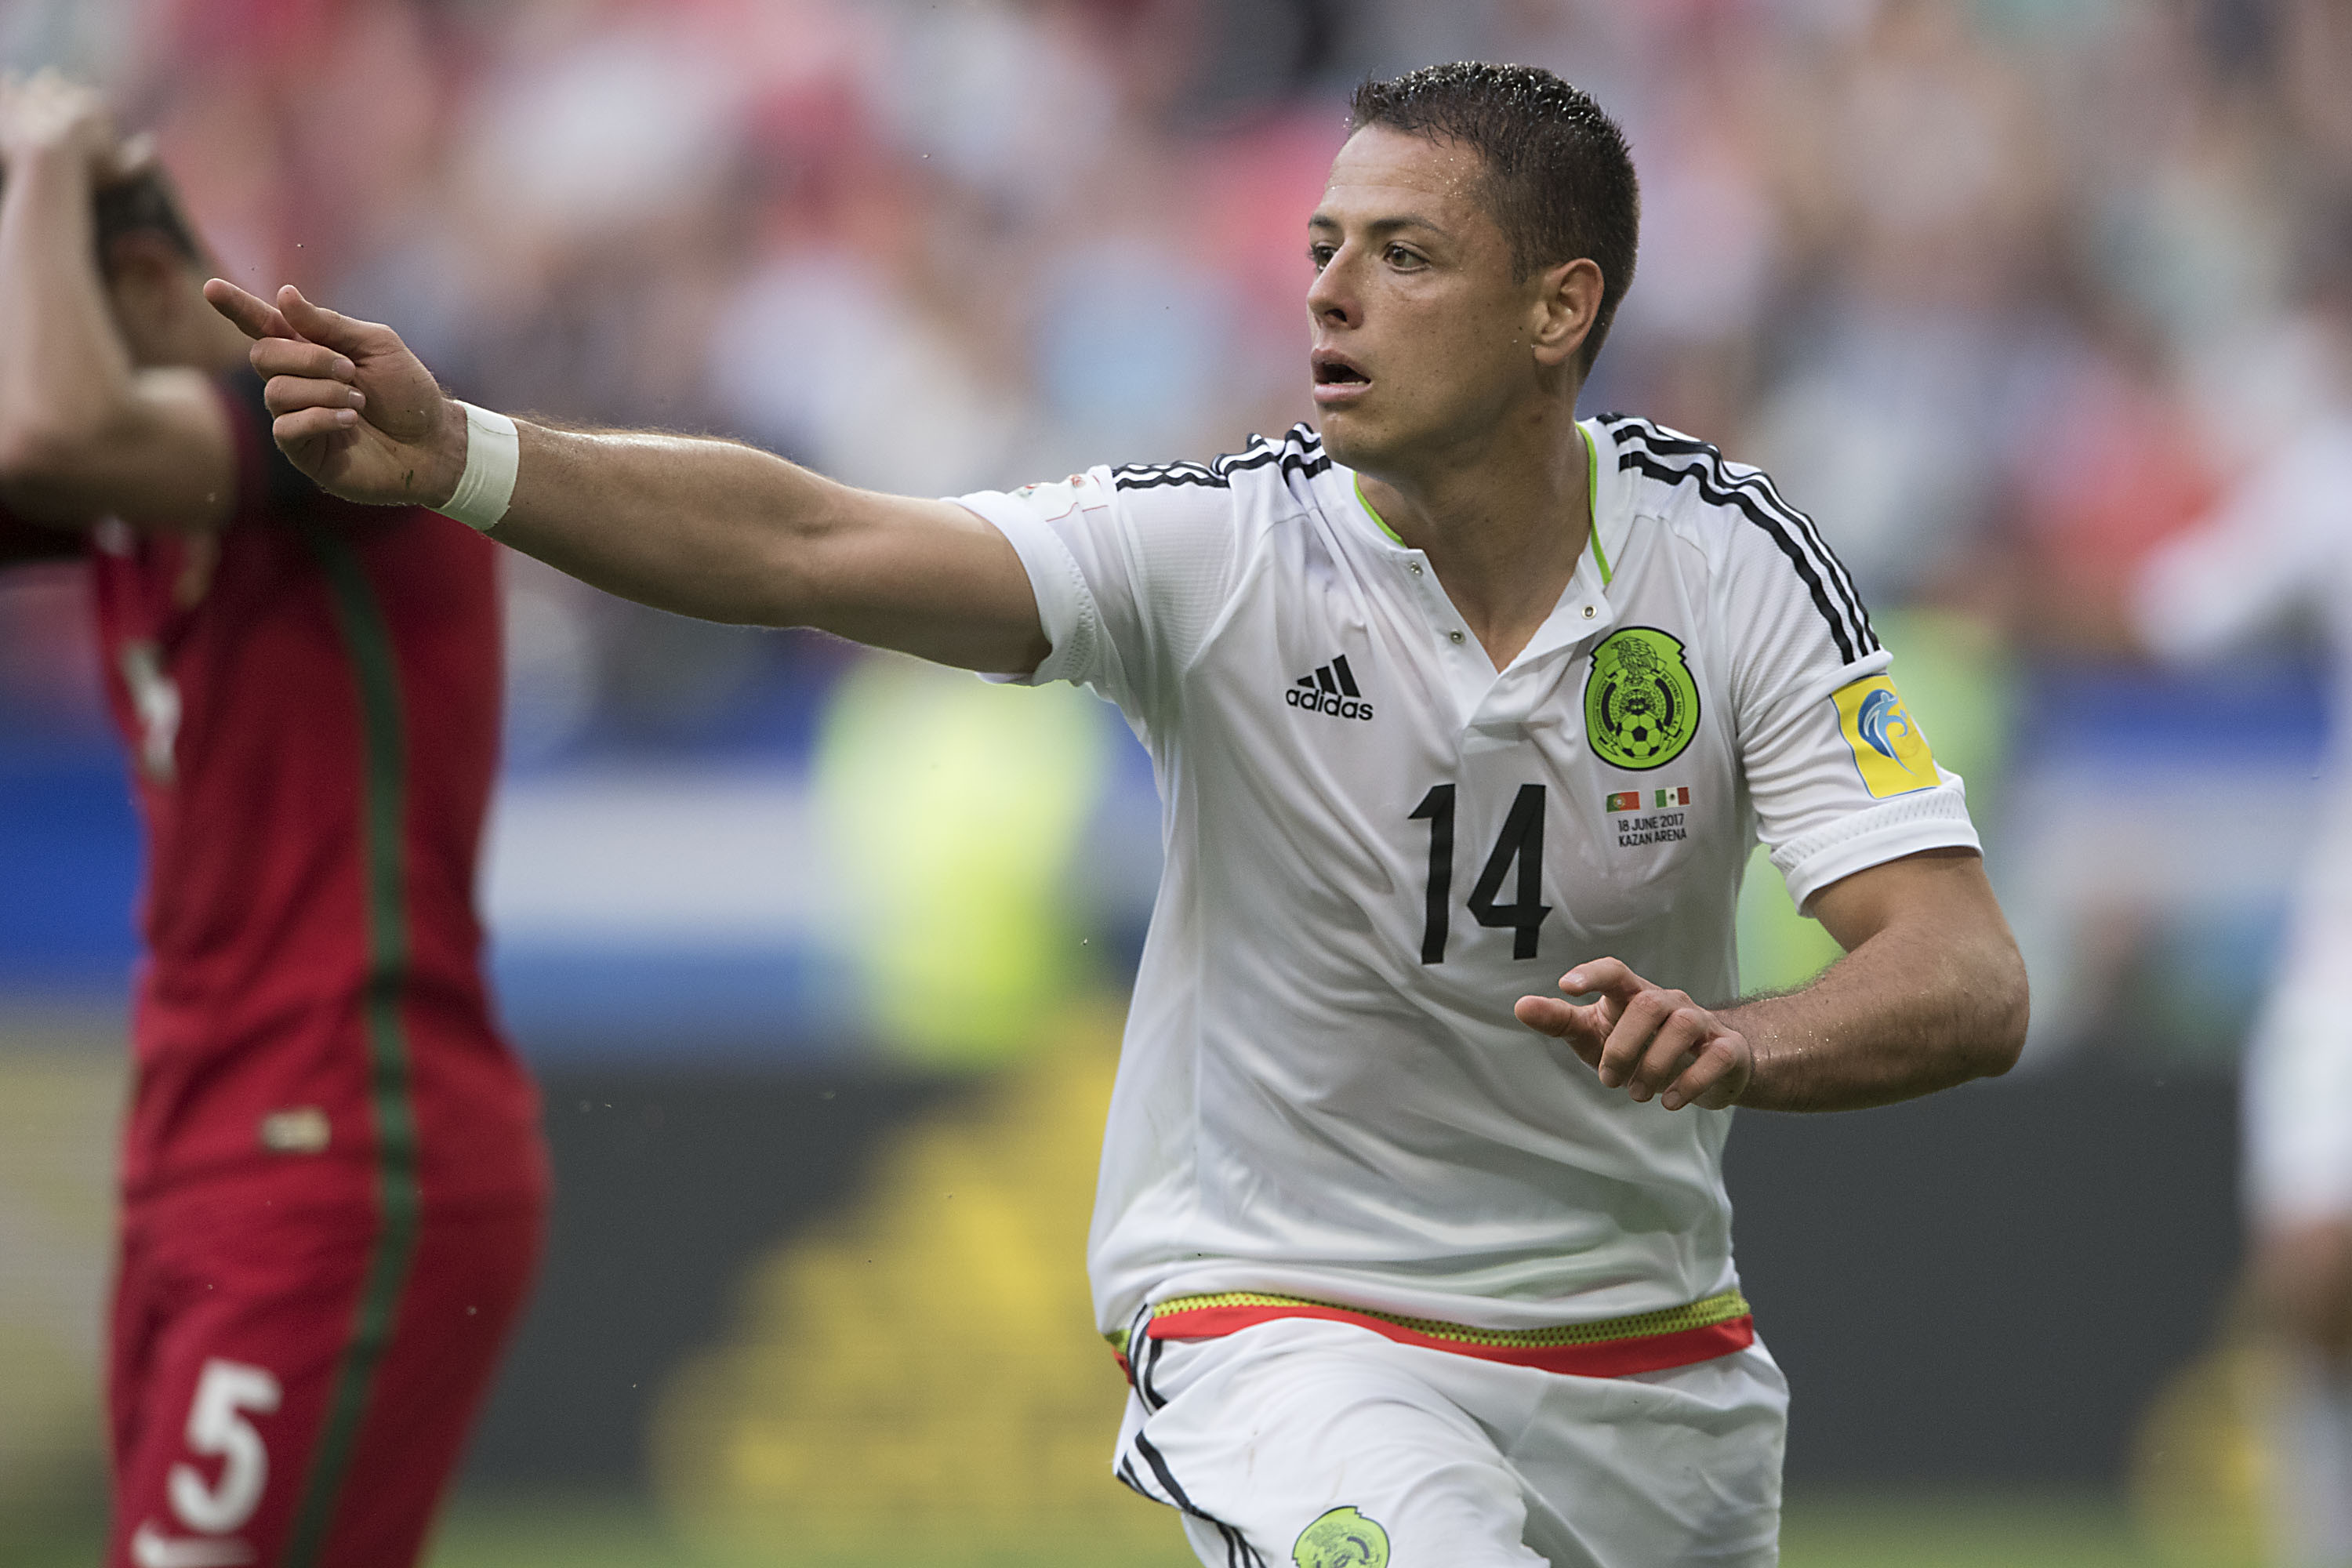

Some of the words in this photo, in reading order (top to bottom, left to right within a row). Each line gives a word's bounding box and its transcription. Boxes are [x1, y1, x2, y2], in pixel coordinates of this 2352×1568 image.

[1286, 688, 1374, 720] adidas
[1618, 819, 1630, 832] 18
[1632, 816, 1658, 831] JUNE
[1660, 813, 1684, 828] 2017
[1618, 833, 1652, 847] KAZAN
[1654, 827, 1687, 843] ARENA
[1408, 783, 1552, 964] 14
[167, 1357, 283, 1534] 5
